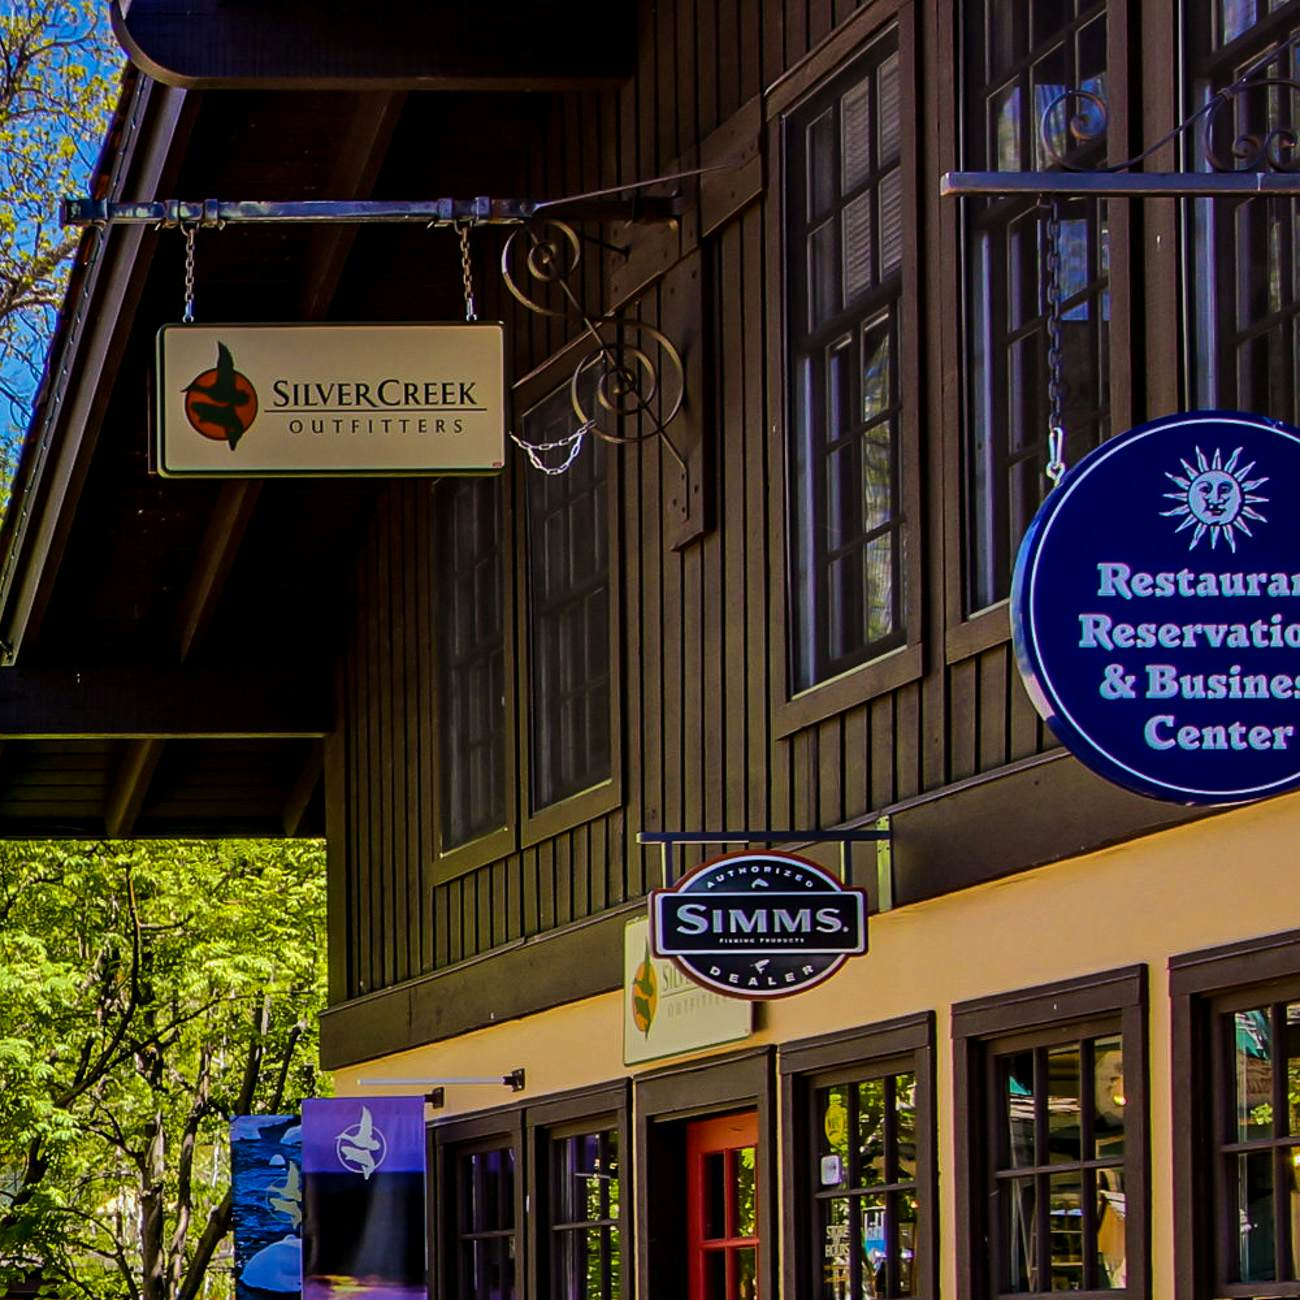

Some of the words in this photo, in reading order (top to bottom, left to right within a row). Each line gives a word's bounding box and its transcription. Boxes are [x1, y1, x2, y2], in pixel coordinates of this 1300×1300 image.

[288, 417, 464, 435] OUTFITTERS
[1099, 663, 1136, 700] &
[1144, 714, 1294, 750] Center
[706, 865, 814, 889] AUTHORIZED
[710, 966, 815, 986] DEALER
